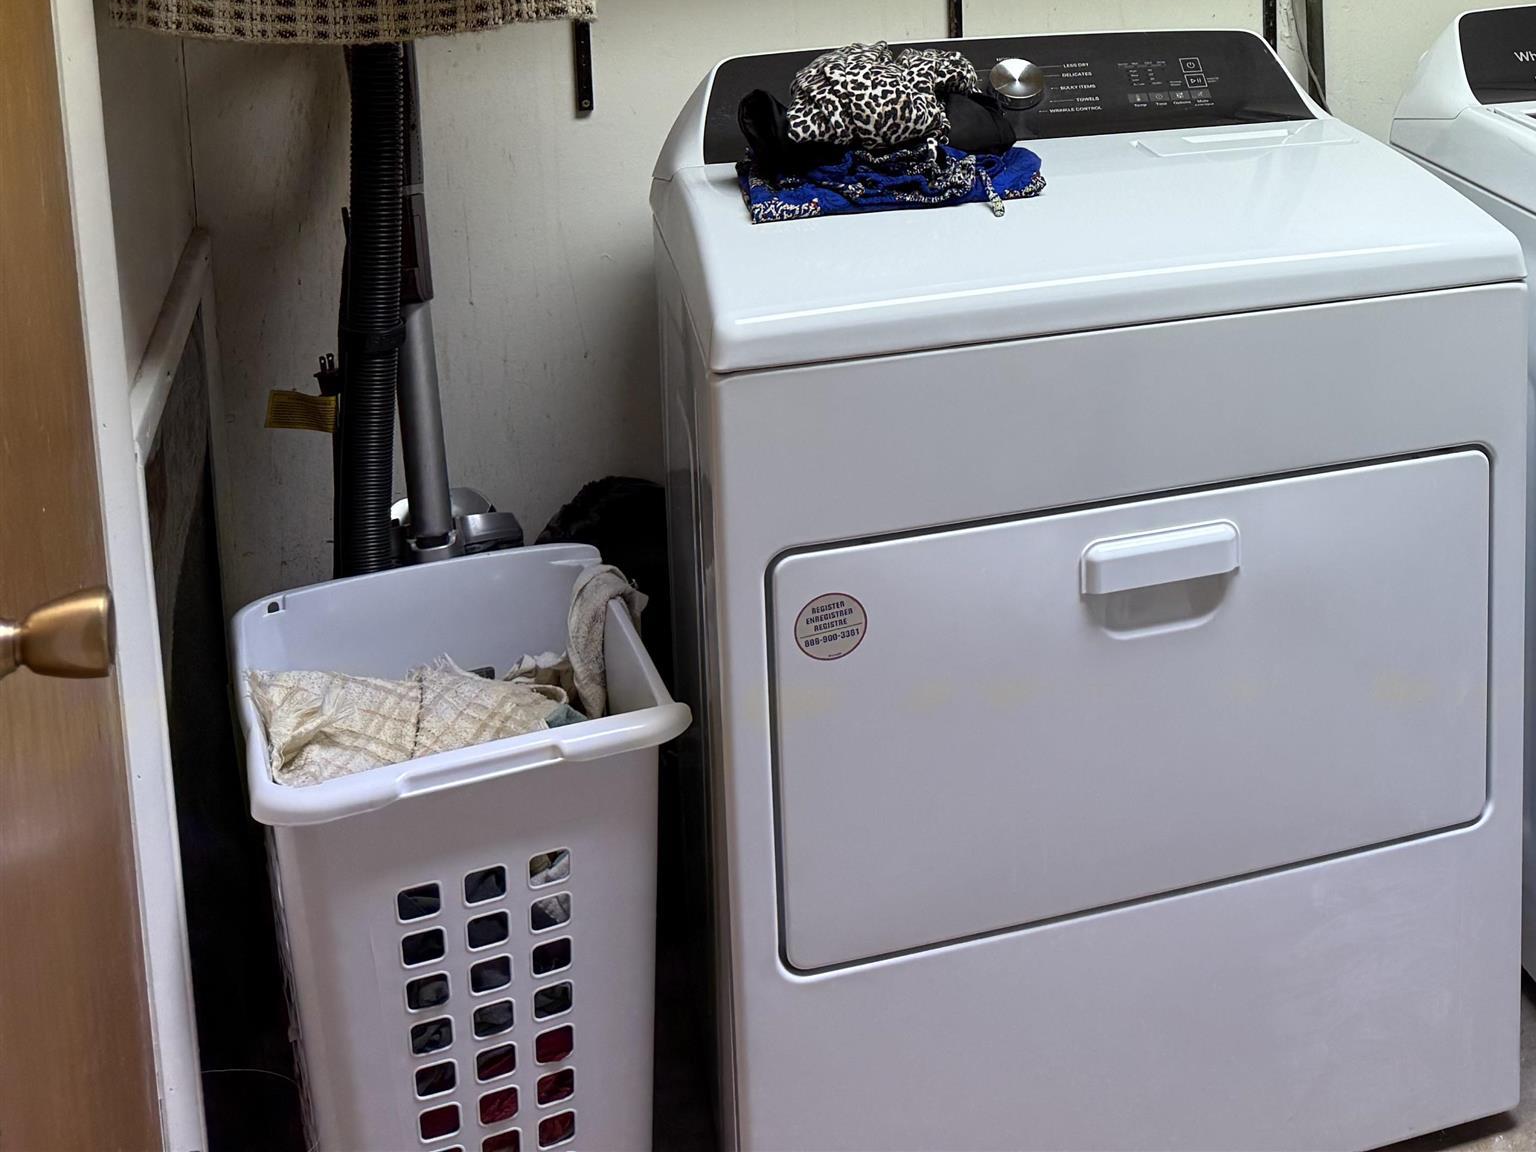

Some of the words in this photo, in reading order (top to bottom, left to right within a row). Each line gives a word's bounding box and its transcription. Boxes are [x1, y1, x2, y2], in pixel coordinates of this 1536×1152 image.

[811, 600, 845, 615] REGISTER
[805, 608, 854, 625] ENREGISTRER
[813, 617, 848, 632] REGISTRE
